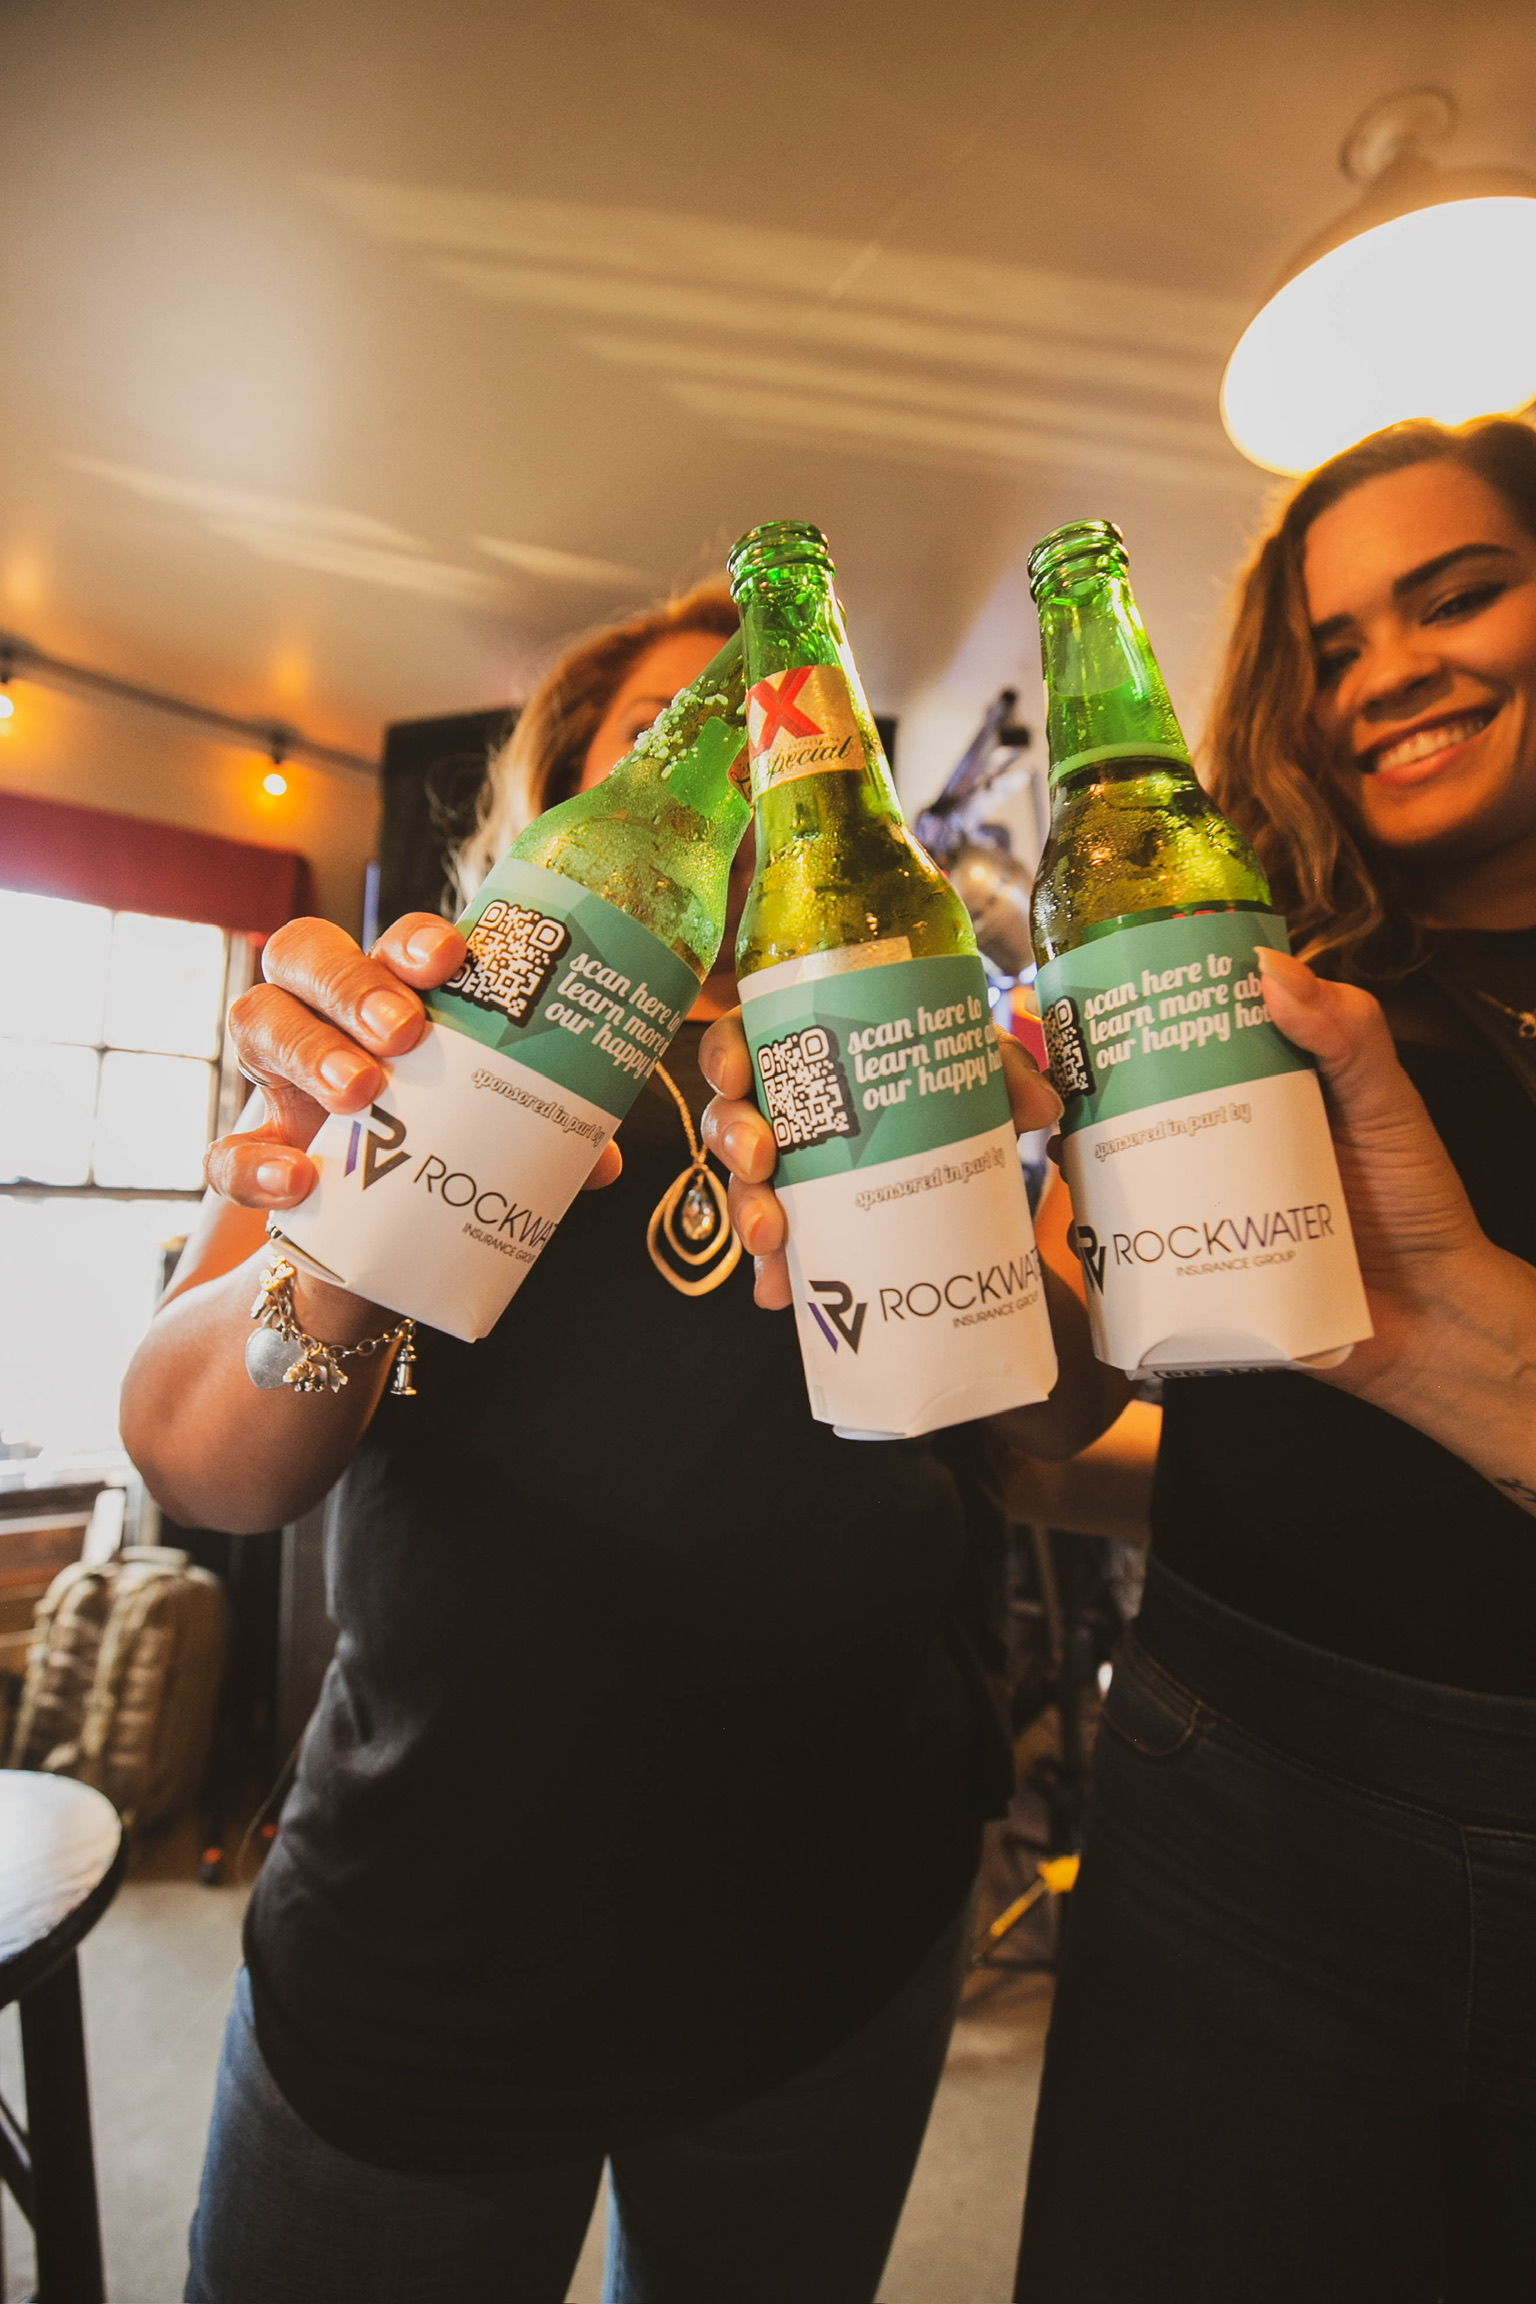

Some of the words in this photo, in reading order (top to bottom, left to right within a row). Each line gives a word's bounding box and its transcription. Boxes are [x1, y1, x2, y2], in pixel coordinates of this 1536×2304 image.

[557, 972, 625, 1026] learn
[622, 1015, 666, 1053] more
[569, 953, 632, 998] scan
[628, 982, 673, 1025] here
[1083, 981, 1139, 1020] scan
[1141, 961, 1202, 998] here
[1207, 953, 1233, 979] to
[1088, 1003, 1156, 1046] learn
[1159, 984, 1230, 1022] more
[544, 1002, 595, 1035] our
[592, 1022, 651, 1080] happy
[846, 1017, 914, 1055] scan
[917, 1003, 966, 1037] here
[967, 995, 982, 1021] to
[854, 1043, 931, 1083] learn
[934, 1027, 984, 1061] more
[1095, 1036, 1137, 1070] our
[1141, 1011, 1232, 1054] happy
[470, 1068, 557, 1119] sponsored
[551, 1105, 570, 1127] in
[563, 1116, 597, 1139] part
[862, 1078, 912, 1111] our
[918, 1055, 988, 1096] happy
[1093, 1122, 1166, 1163] sponsored
[1167, 1117, 1188, 1138] in
[1187, 1108, 1228, 1138] part
[1229, 1101, 1252, 1124] by
[855, 1167, 943, 1212] sponsored
[943, 1164, 962, 1184] in
[961, 1151, 992, 1184] part
[462, 1221, 517, 1258] INSURANCE
[1112, 1203, 1335, 1267] ROCKWATER
[1175, 1253, 1251, 1278] INSURANCE
[1252, 1249, 1297, 1267] GROUP
[952, 1302, 1016, 1329] INSURANCE
